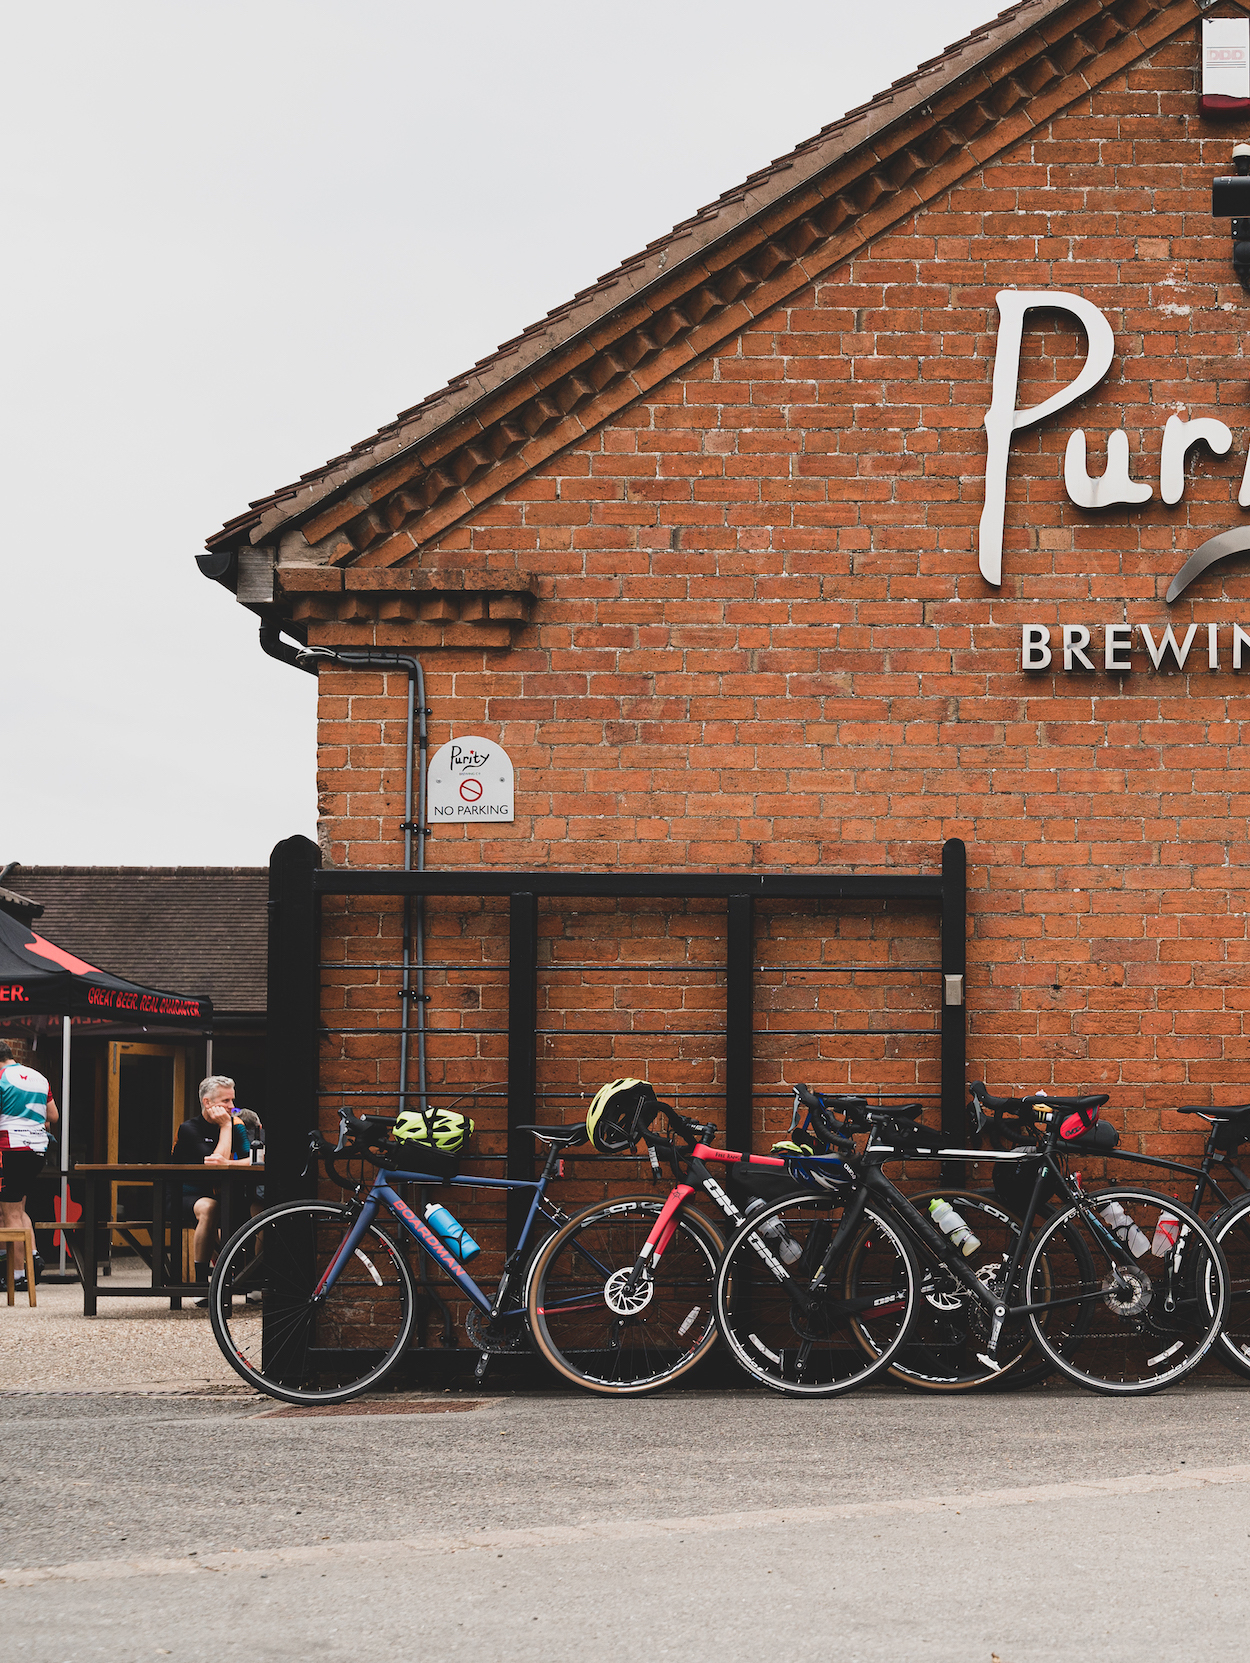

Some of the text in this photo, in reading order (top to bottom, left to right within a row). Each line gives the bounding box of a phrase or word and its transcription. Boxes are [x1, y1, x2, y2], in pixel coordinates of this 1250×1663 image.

[450, 745, 490, 772] Purity
[434, 804, 509, 816] NO PARKING
[87, 987, 202, 1018] GREAT BEER. REAL CHARACTER.
[393, 1199, 466, 1277] BOARDMAN
